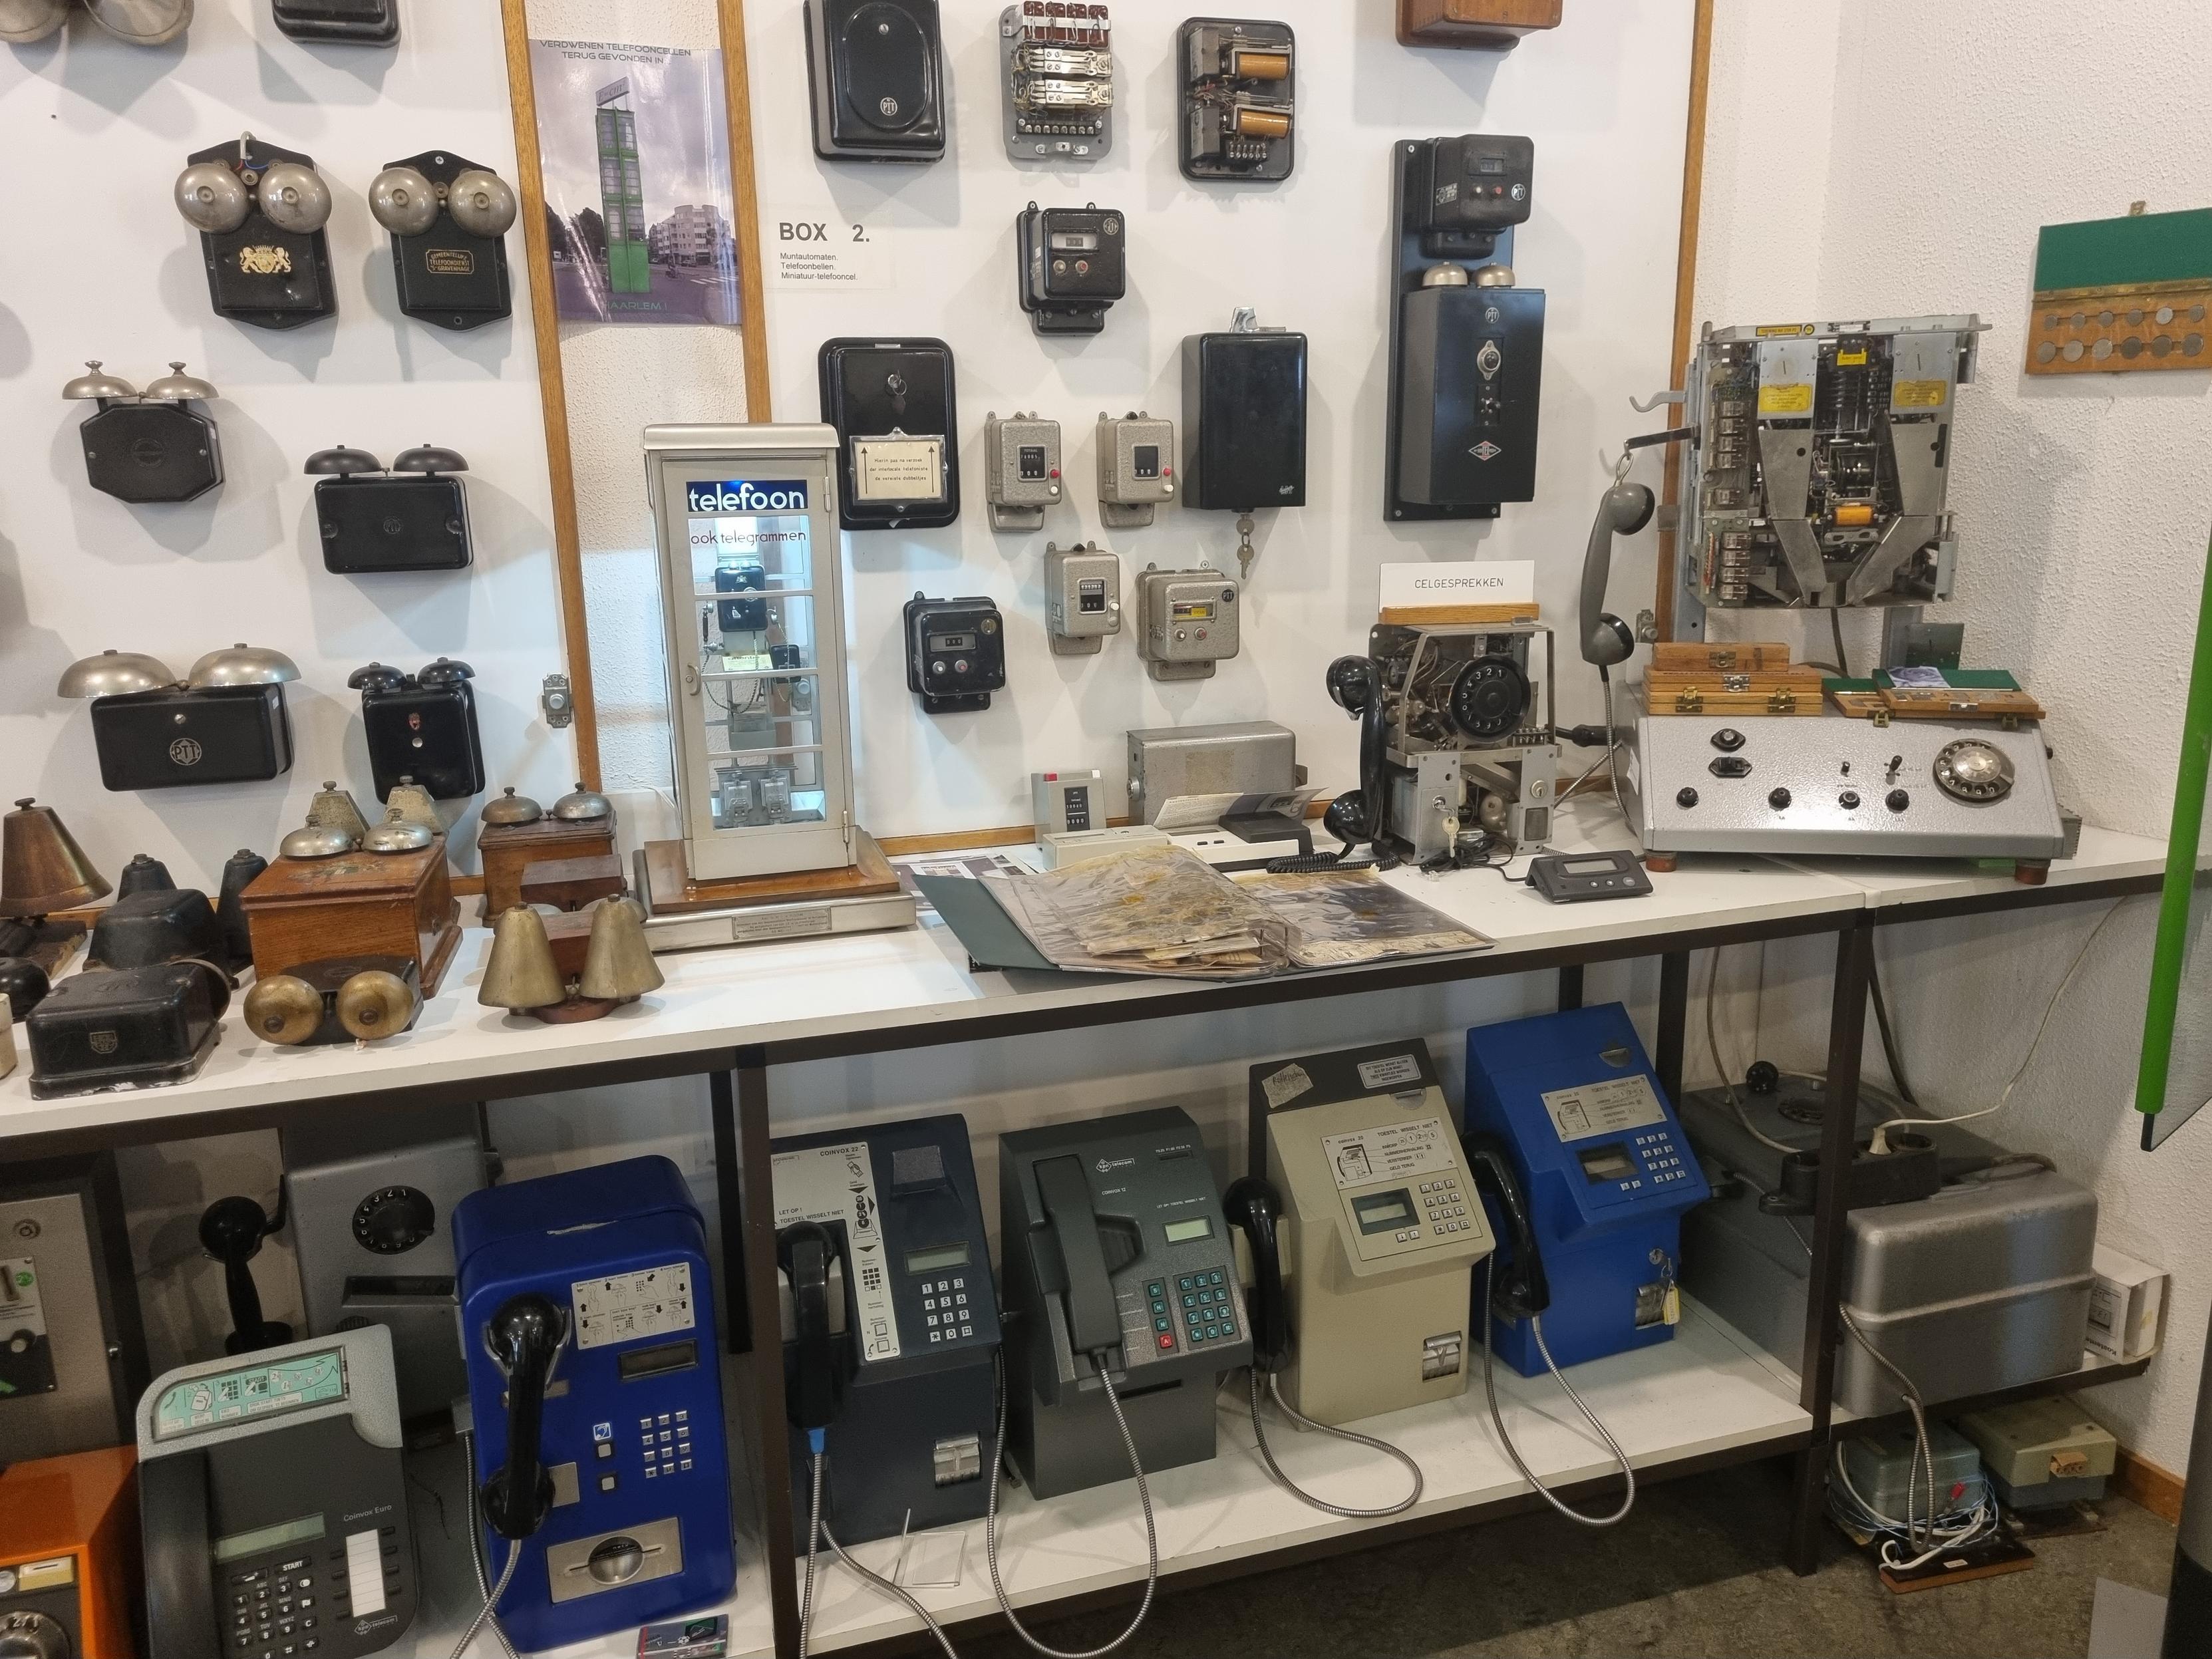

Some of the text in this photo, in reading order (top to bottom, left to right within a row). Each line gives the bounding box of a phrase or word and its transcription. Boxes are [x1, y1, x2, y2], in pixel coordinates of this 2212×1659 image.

[540, 41, 691, 56] VERDWENEN TELEFOONCELLEN
[561, 51, 596, 60] TERUG
[599, 53, 652, 63] GEVONDEN
[779, 222, 869, 242] BOX 2.
[689, 482, 805, 512] telefoon
[691, 529, 806, 546] ook telegrammen
[1414, 577, 1504, 589] CELGESPREKKEN
[1476, 671, 1482, 680] 3
[174, 744, 197, 760] PTT
[820, 1147, 850, 1157] COINVOX
[343, 1504, 393, 1522] Coinvox Euro
[283, 1560, 303, 1571] START
[372, 1618, 395, 1628] telecom
